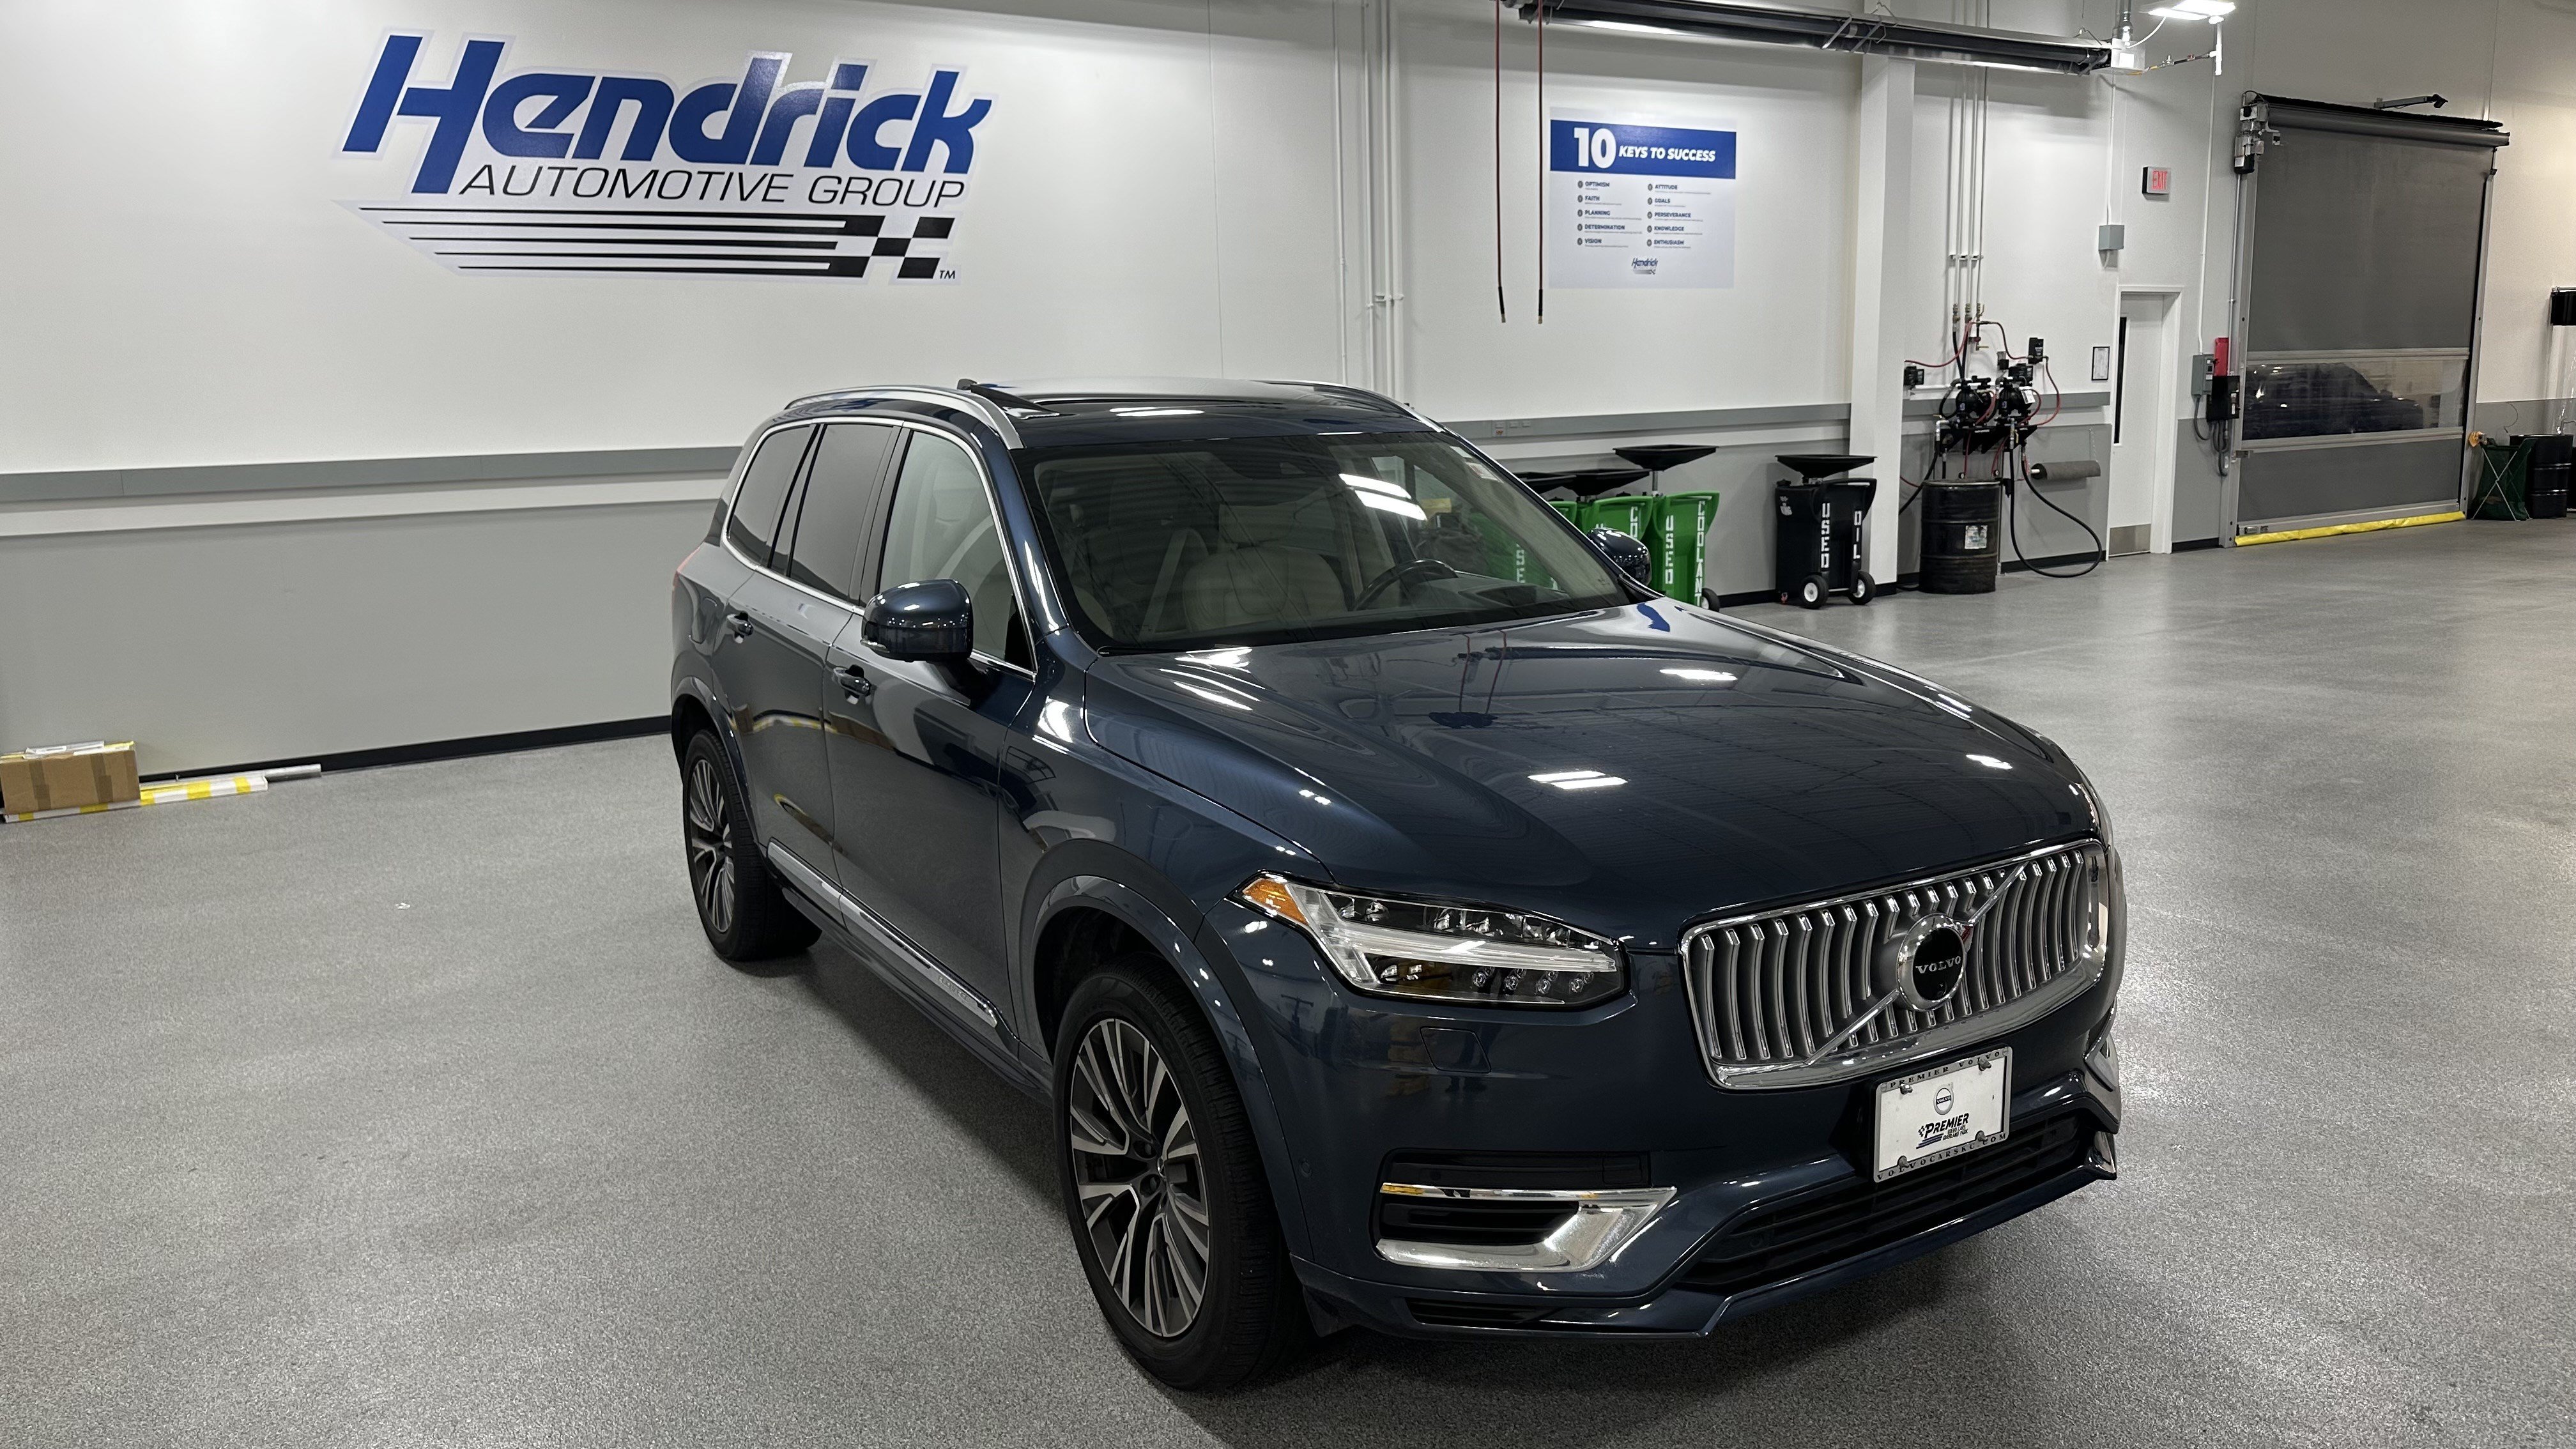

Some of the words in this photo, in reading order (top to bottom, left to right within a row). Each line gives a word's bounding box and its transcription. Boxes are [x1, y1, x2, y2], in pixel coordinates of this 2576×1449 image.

[342, 34, 991, 193] Hendrick
[1574, 127, 1616, 169] 10
[1618, 145, 1648, 158] KEYS
[1650, 147, 1666, 159] TO
[1667, 148, 1716, 162] SUCCESS
[459, 164, 793, 204] AUTOMOTIVE
[808, 176, 964, 208] GROUP
[2152, 171, 2167, 190] EXIT
[940, 270, 955, 279] TM
[1665, 515, 1674, 585] USED
[1694, 501, 1706, 607] COOLANT
[1821, 502, 1830, 569] USED
[1853, 510, 1862, 559] OIL
[1915, 955, 1961, 974] VOLVO
[1890, 1066, 1949, 1088] PREMIER
[1924, 1112, 1969, 1138] PREMIER
